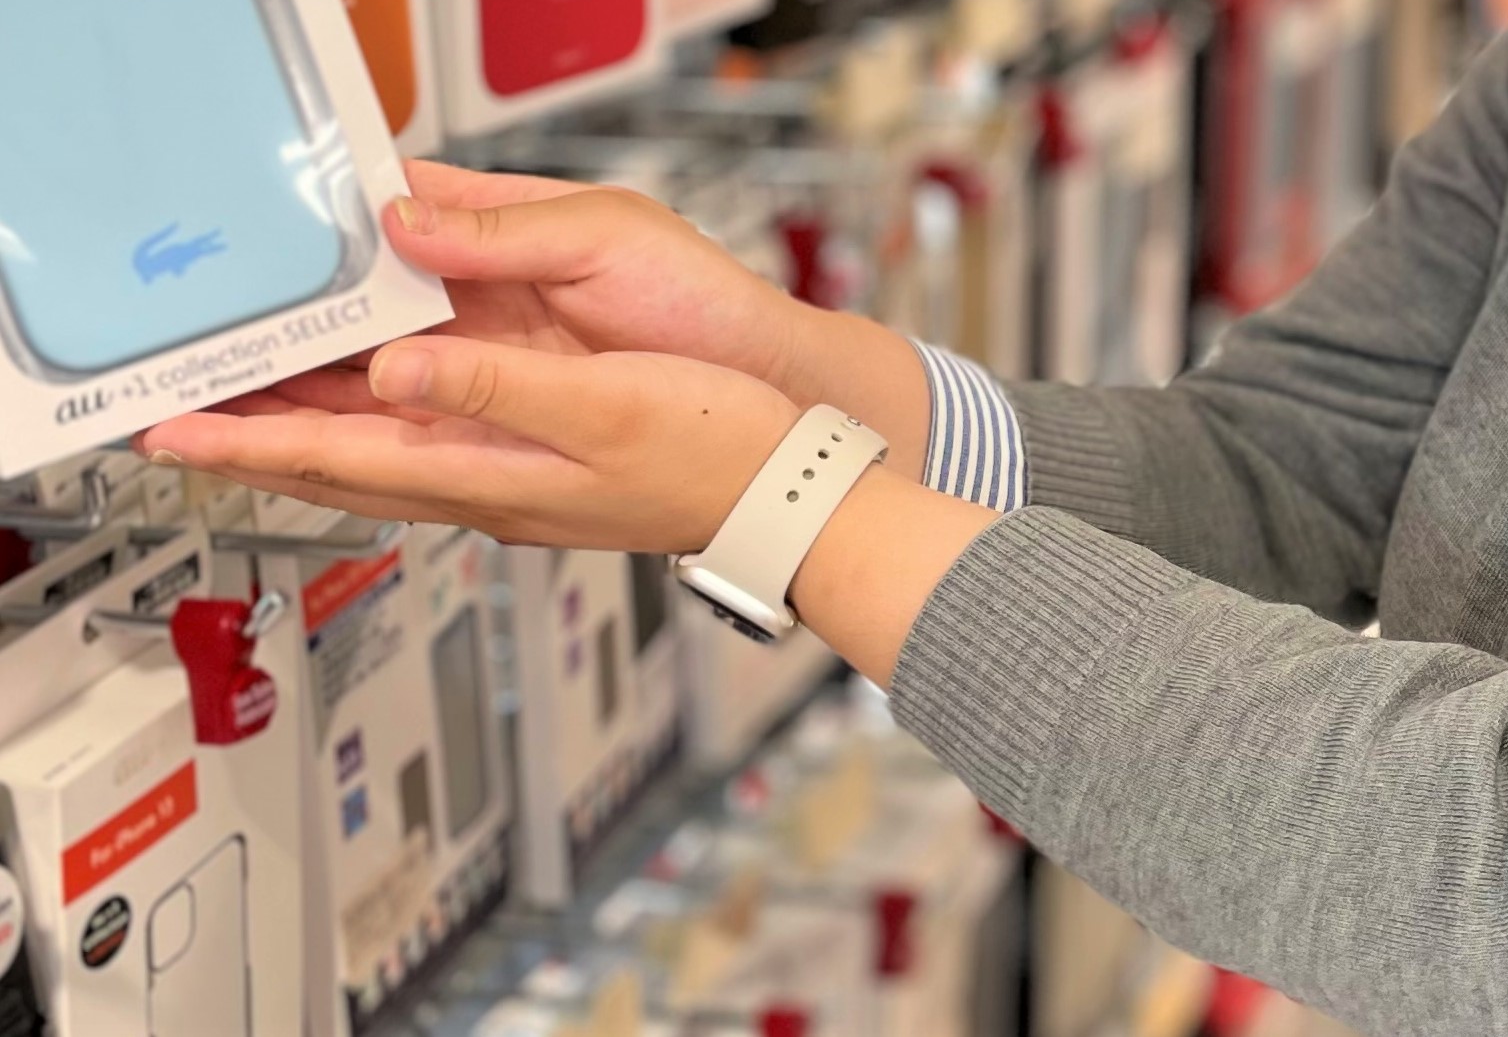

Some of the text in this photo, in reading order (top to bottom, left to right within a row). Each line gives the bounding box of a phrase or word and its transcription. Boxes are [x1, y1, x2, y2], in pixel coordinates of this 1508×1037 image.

[54, 386, 112, 426] au
[156, 331, 282, 391] collection
[284, 294, 373, 346] SELECT
